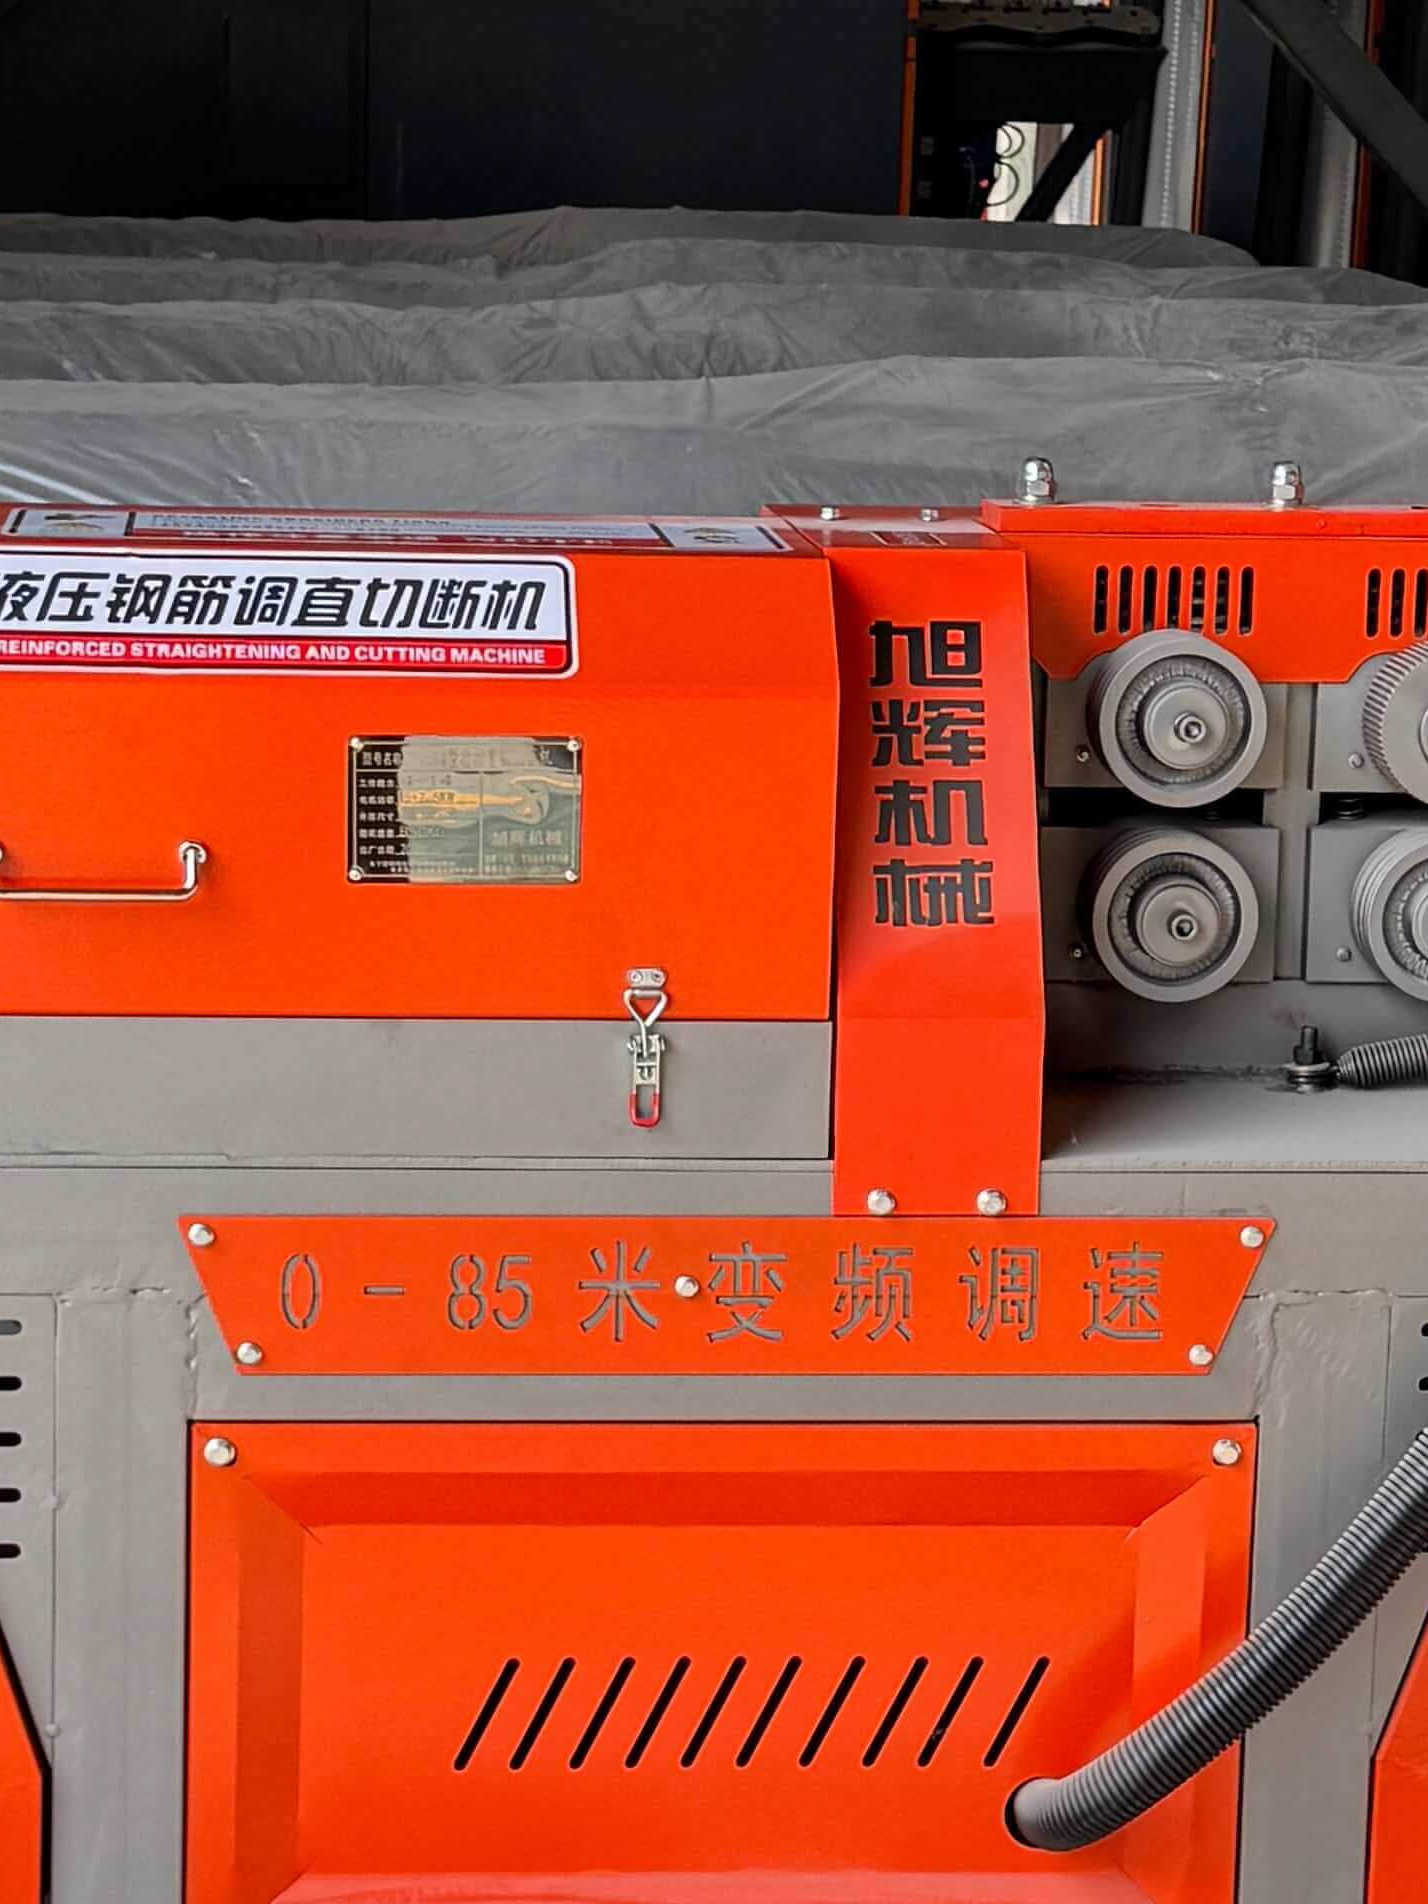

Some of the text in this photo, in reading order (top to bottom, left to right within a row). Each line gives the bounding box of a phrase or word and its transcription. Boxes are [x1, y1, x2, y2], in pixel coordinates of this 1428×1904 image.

[130, 642, 301, 662] STRAIGHTENING
[304, 646, 350, 663] AND
[354, 647, 446, 665] CUTTING
[450, 648, 547, 666] MACHINE
[869, 618, 995, 928] 旭辉机械
